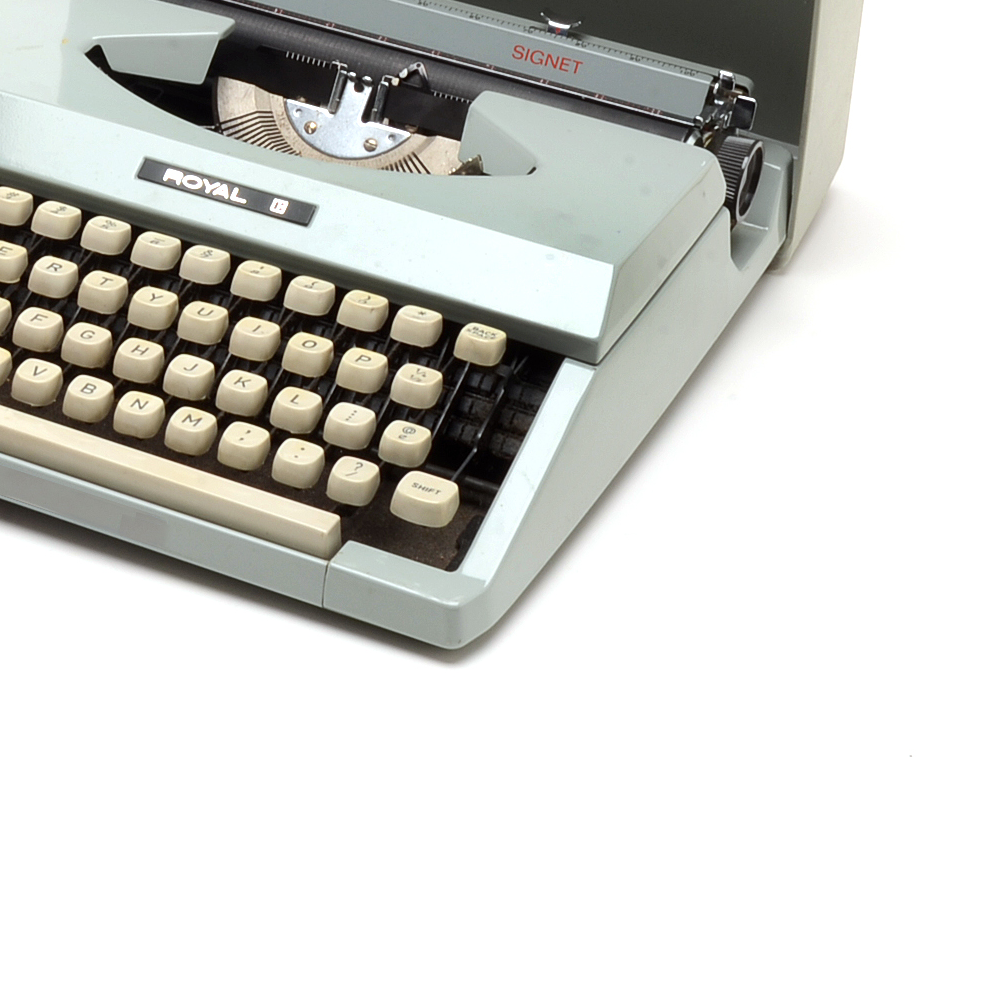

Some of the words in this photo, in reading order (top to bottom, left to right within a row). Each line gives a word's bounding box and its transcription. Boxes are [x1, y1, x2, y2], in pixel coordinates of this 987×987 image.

[511, 44, 584, 75] SIGNET
[162, 167, 248, 205] ROYAL
[46, 262, 63, 272] R
[99, 276, 114, 286] T
[149, 292, 164, 302] Y
[29, 313, 49, 322] F
[196, 307, 214, 317] U
[79, 329, 96, 340] G
[301, 339, 318, 349] O
[130, 344, 150, 356] H
[354, 354, 372, 363] P
[32, 365, 48, 377] V
[183, 363, 199, 372] J
[233, 376, 252, 388] K
[80, 382, 97, 395] B
[130, 398, 149, 410] N
[289, 394, 300, 405] L
[181, 413, 203, 427] M
[411, 481, 442, 496] SHIFT
